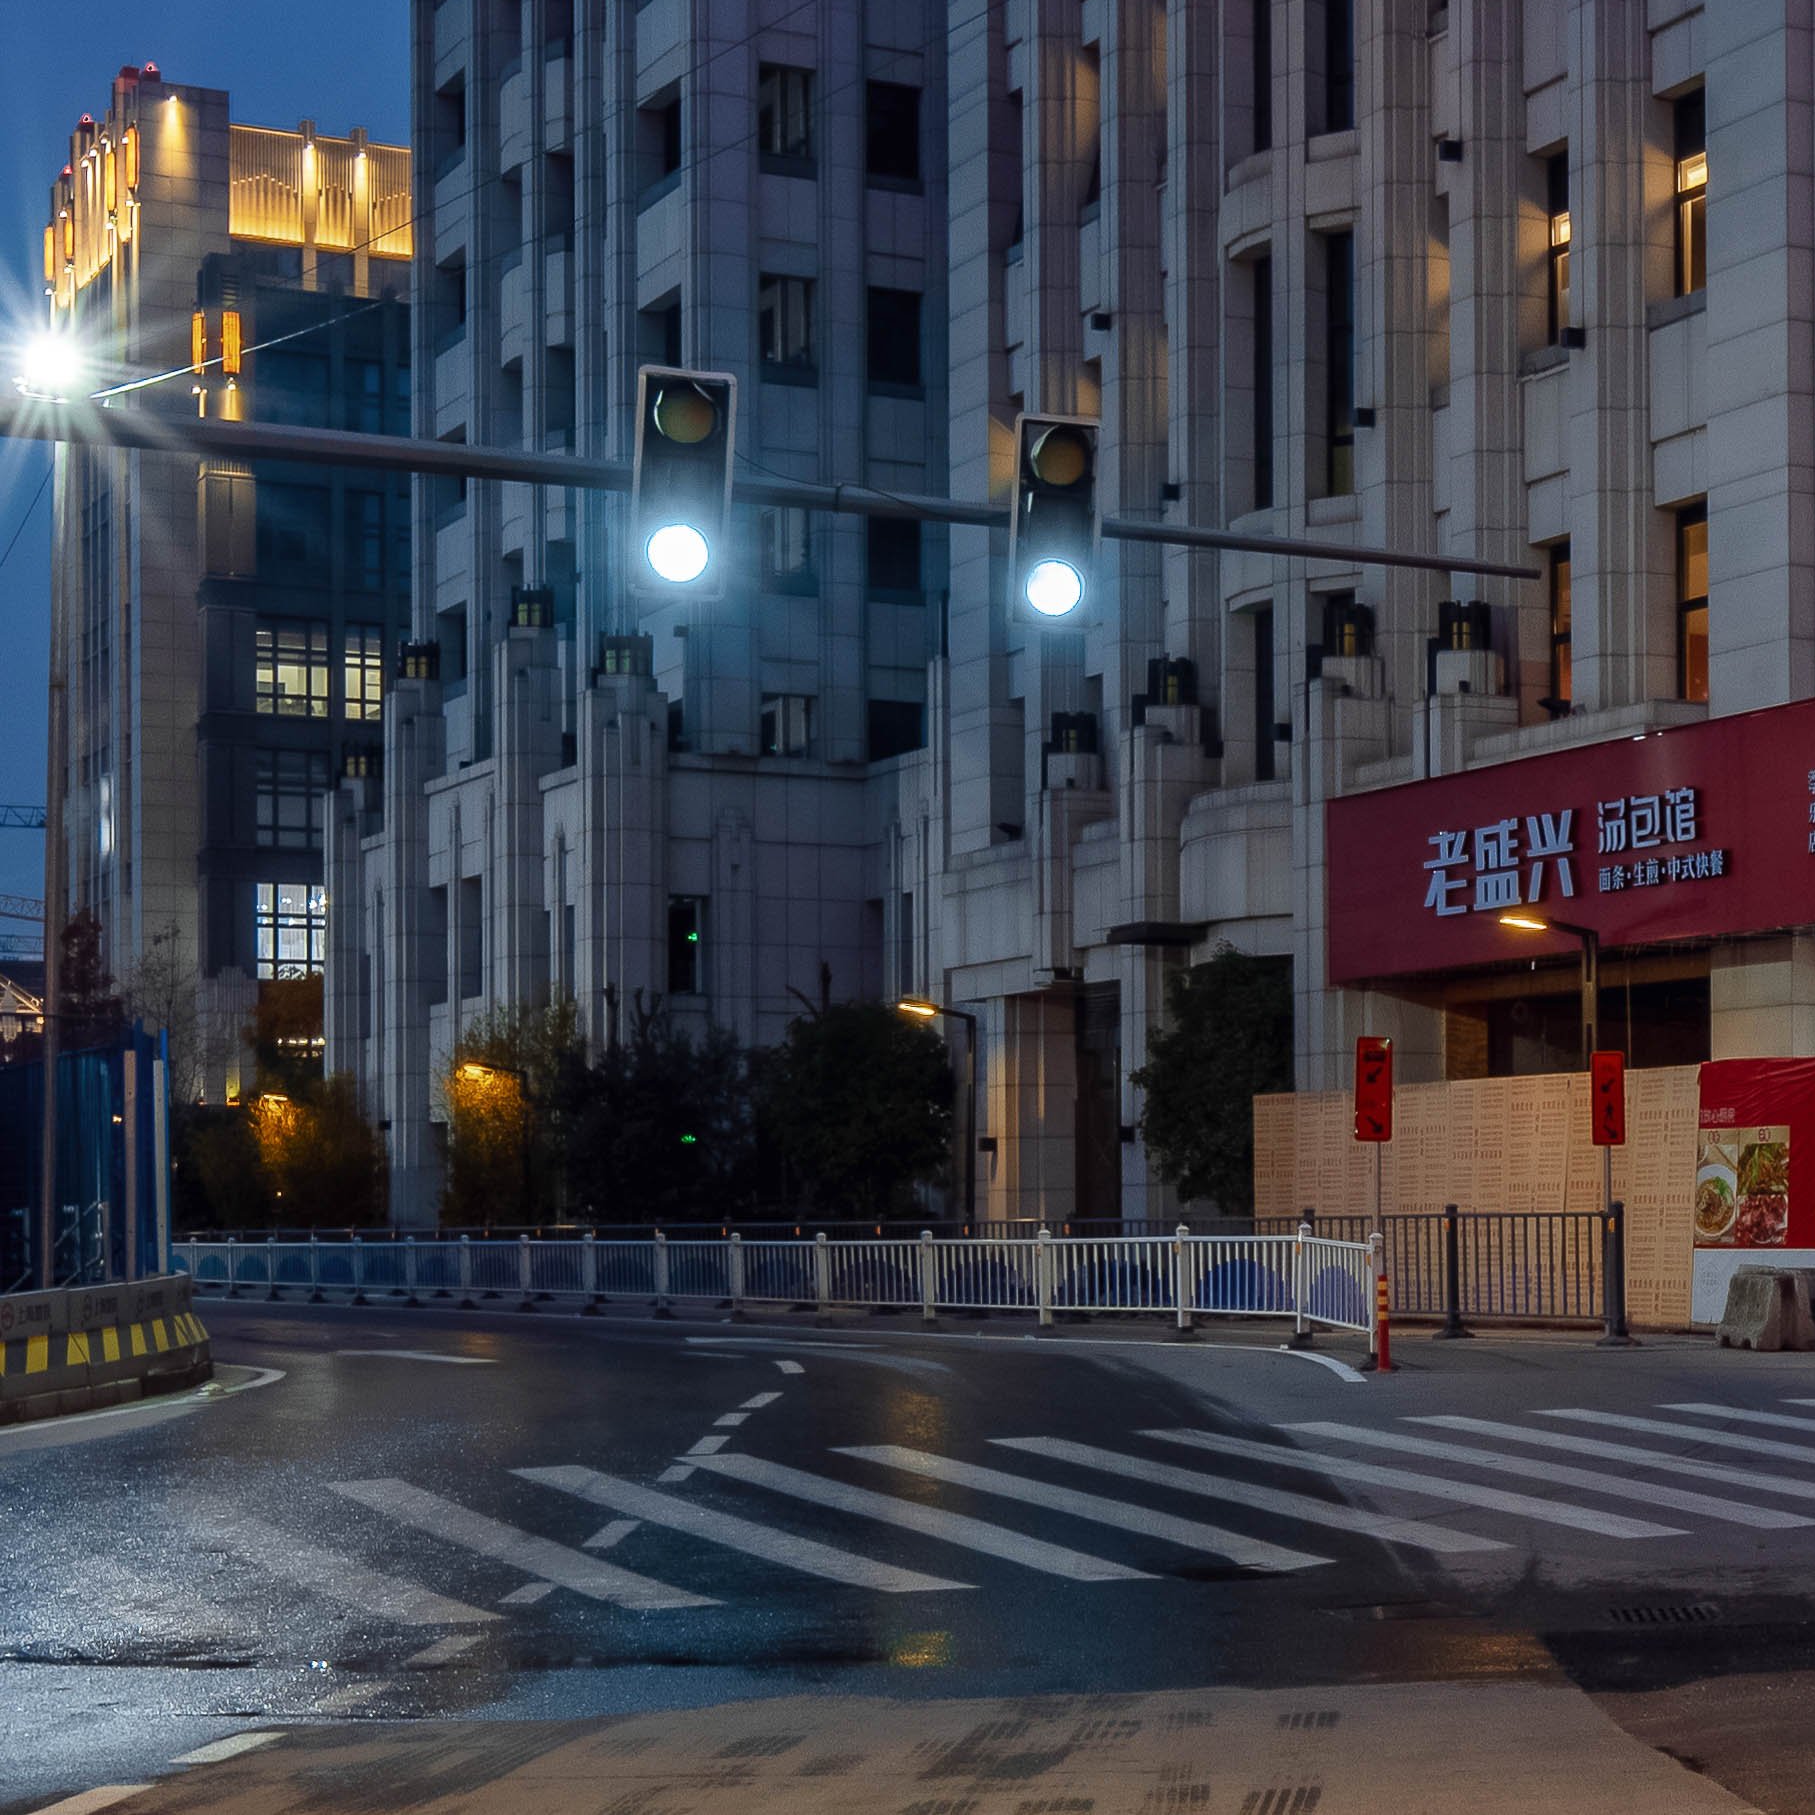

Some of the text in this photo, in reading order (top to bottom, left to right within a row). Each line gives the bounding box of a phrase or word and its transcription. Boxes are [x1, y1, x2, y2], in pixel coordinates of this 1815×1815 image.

[1423, 808, 1575, 917] 老盛兴
[1597, 786, 1697, 854] 汤包馆
